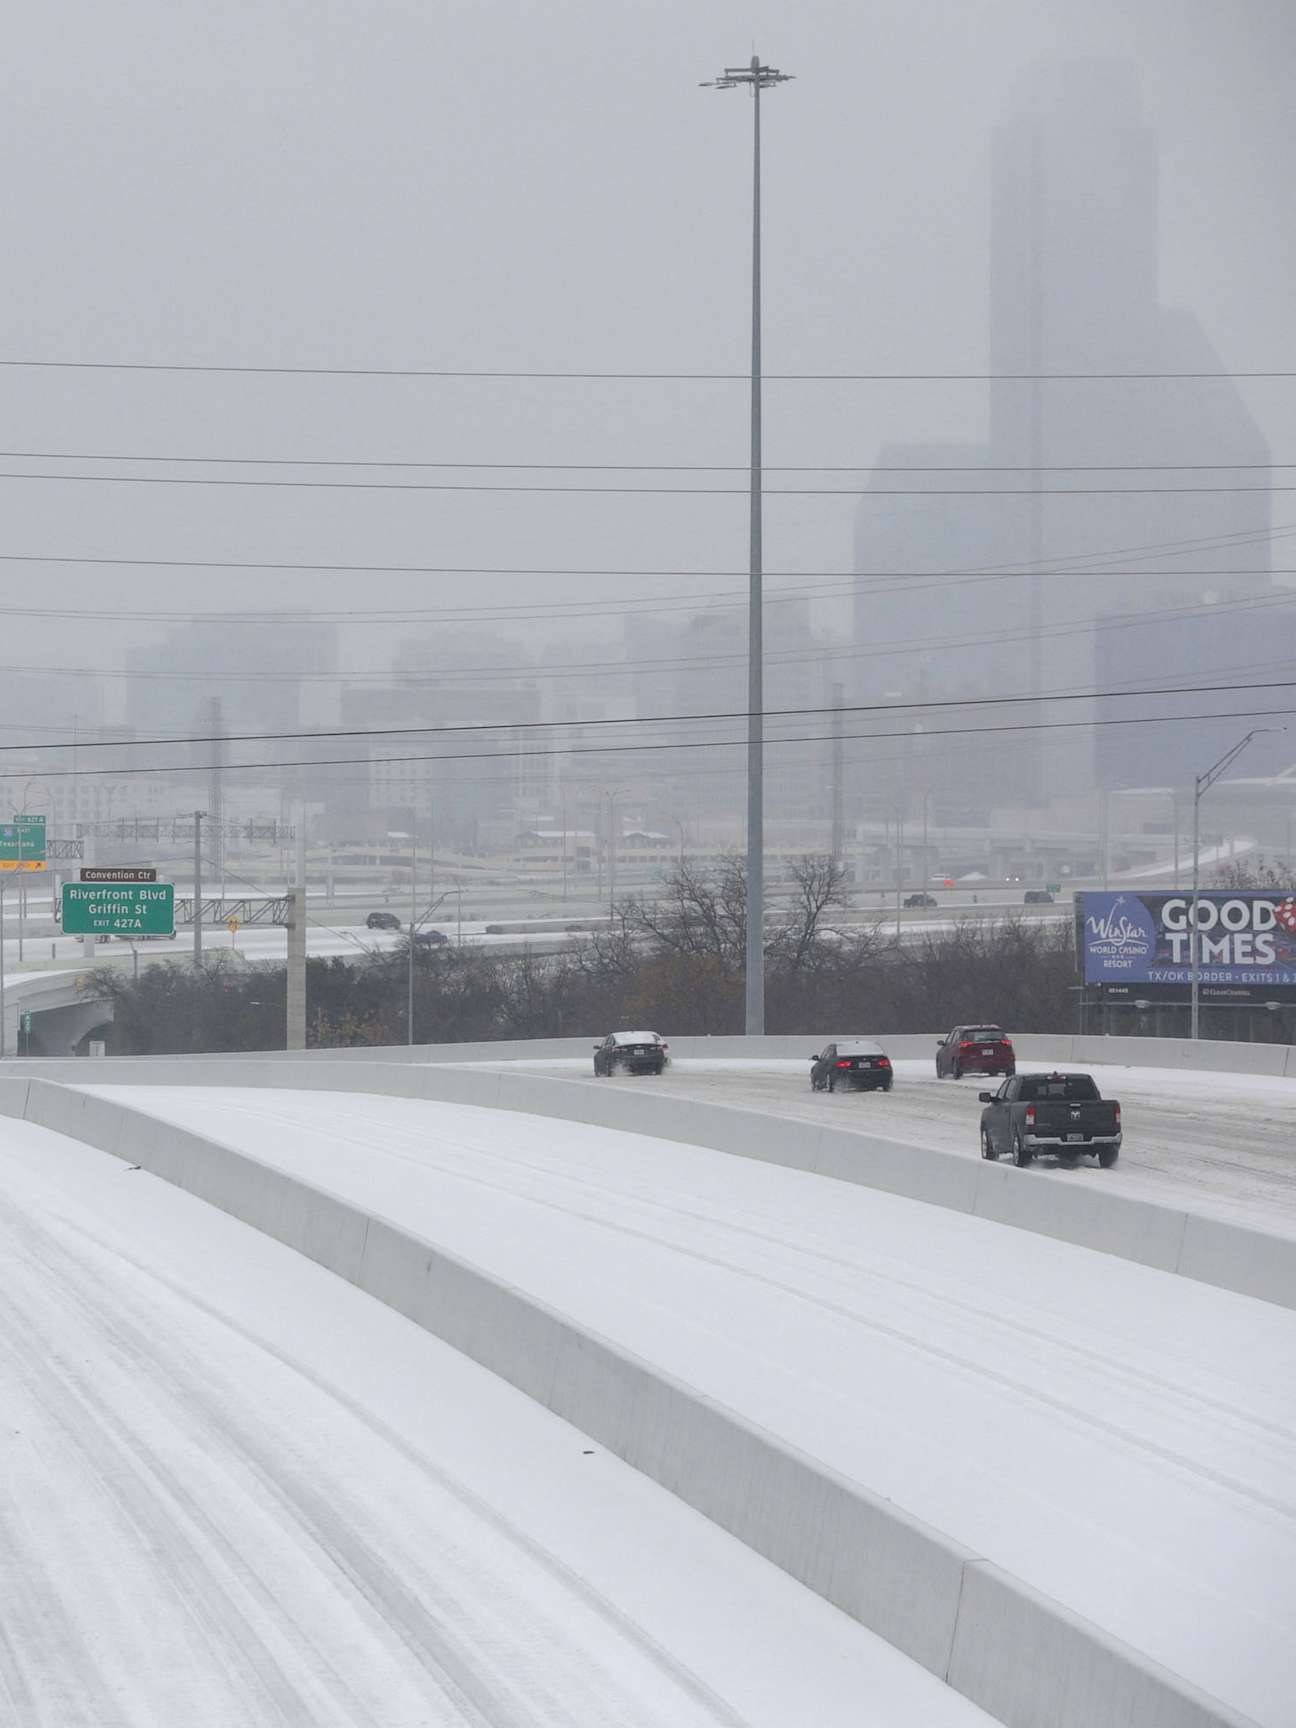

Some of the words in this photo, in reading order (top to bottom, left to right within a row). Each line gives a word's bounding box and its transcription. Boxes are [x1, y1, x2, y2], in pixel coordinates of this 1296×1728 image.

[85, 871, 135, 880] Convention
[138, 871, 151, 880] Ctr
[69, 889, 133, 900] Riverfront
[139, 889, 167, 900] Blvd
[88, 904, 129, 914] Griffin
[135, 904, 147, 914] St
[1161, 899, 1277, 931] GOOD
[113, 919, 142, 928] 427A
[1089, 945, 1116, 954] WORLD
[1118, 945, 1147, 954] CASINO
[1165, 932, 1277, 965] TIMES
[1103, 959, 1133, 968] RESORT
[1148, 971, 1184, 982] TX/OK
[1241, 972, 1273, 983] EXITS
